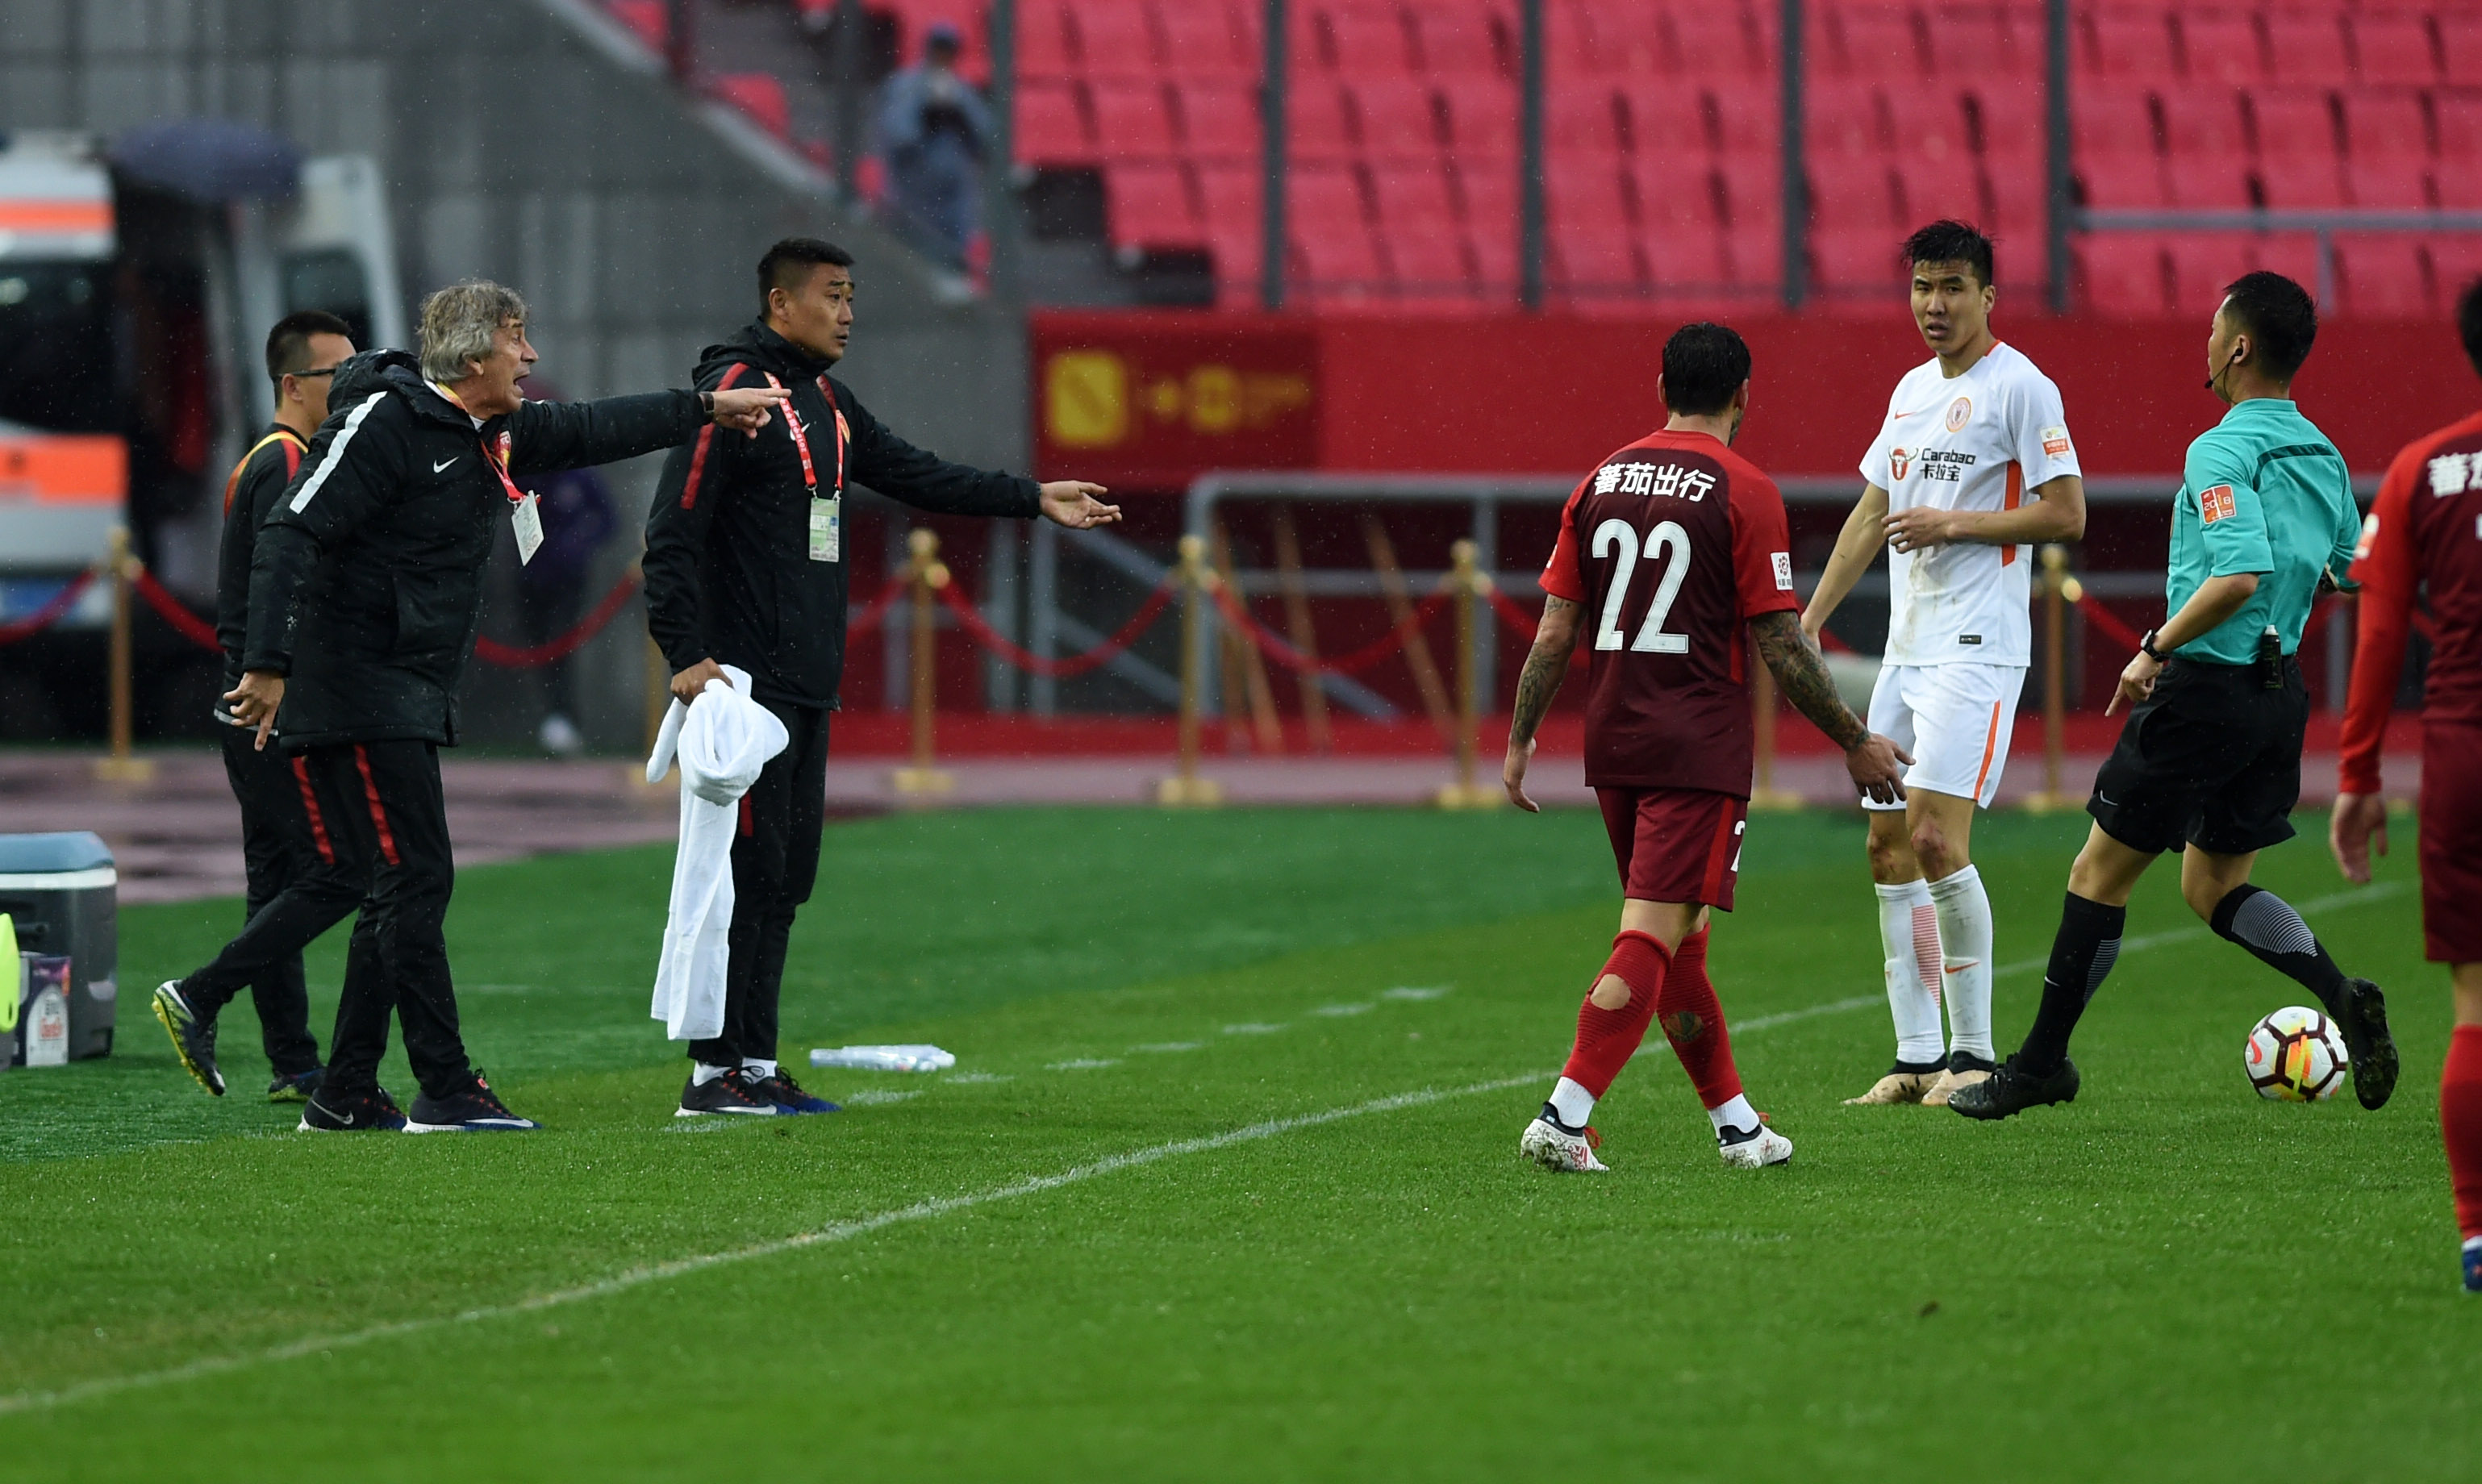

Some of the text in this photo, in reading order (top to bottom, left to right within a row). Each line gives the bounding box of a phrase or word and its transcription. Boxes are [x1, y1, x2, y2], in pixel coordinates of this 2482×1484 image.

[1921, 448, 1976, 465] Carabao
[1595, 462, 1716, 502] 蕃茄出行
[1919, 463, 1961, 481] 卡拉宝
[1592, 518, 1691, 653] 22
